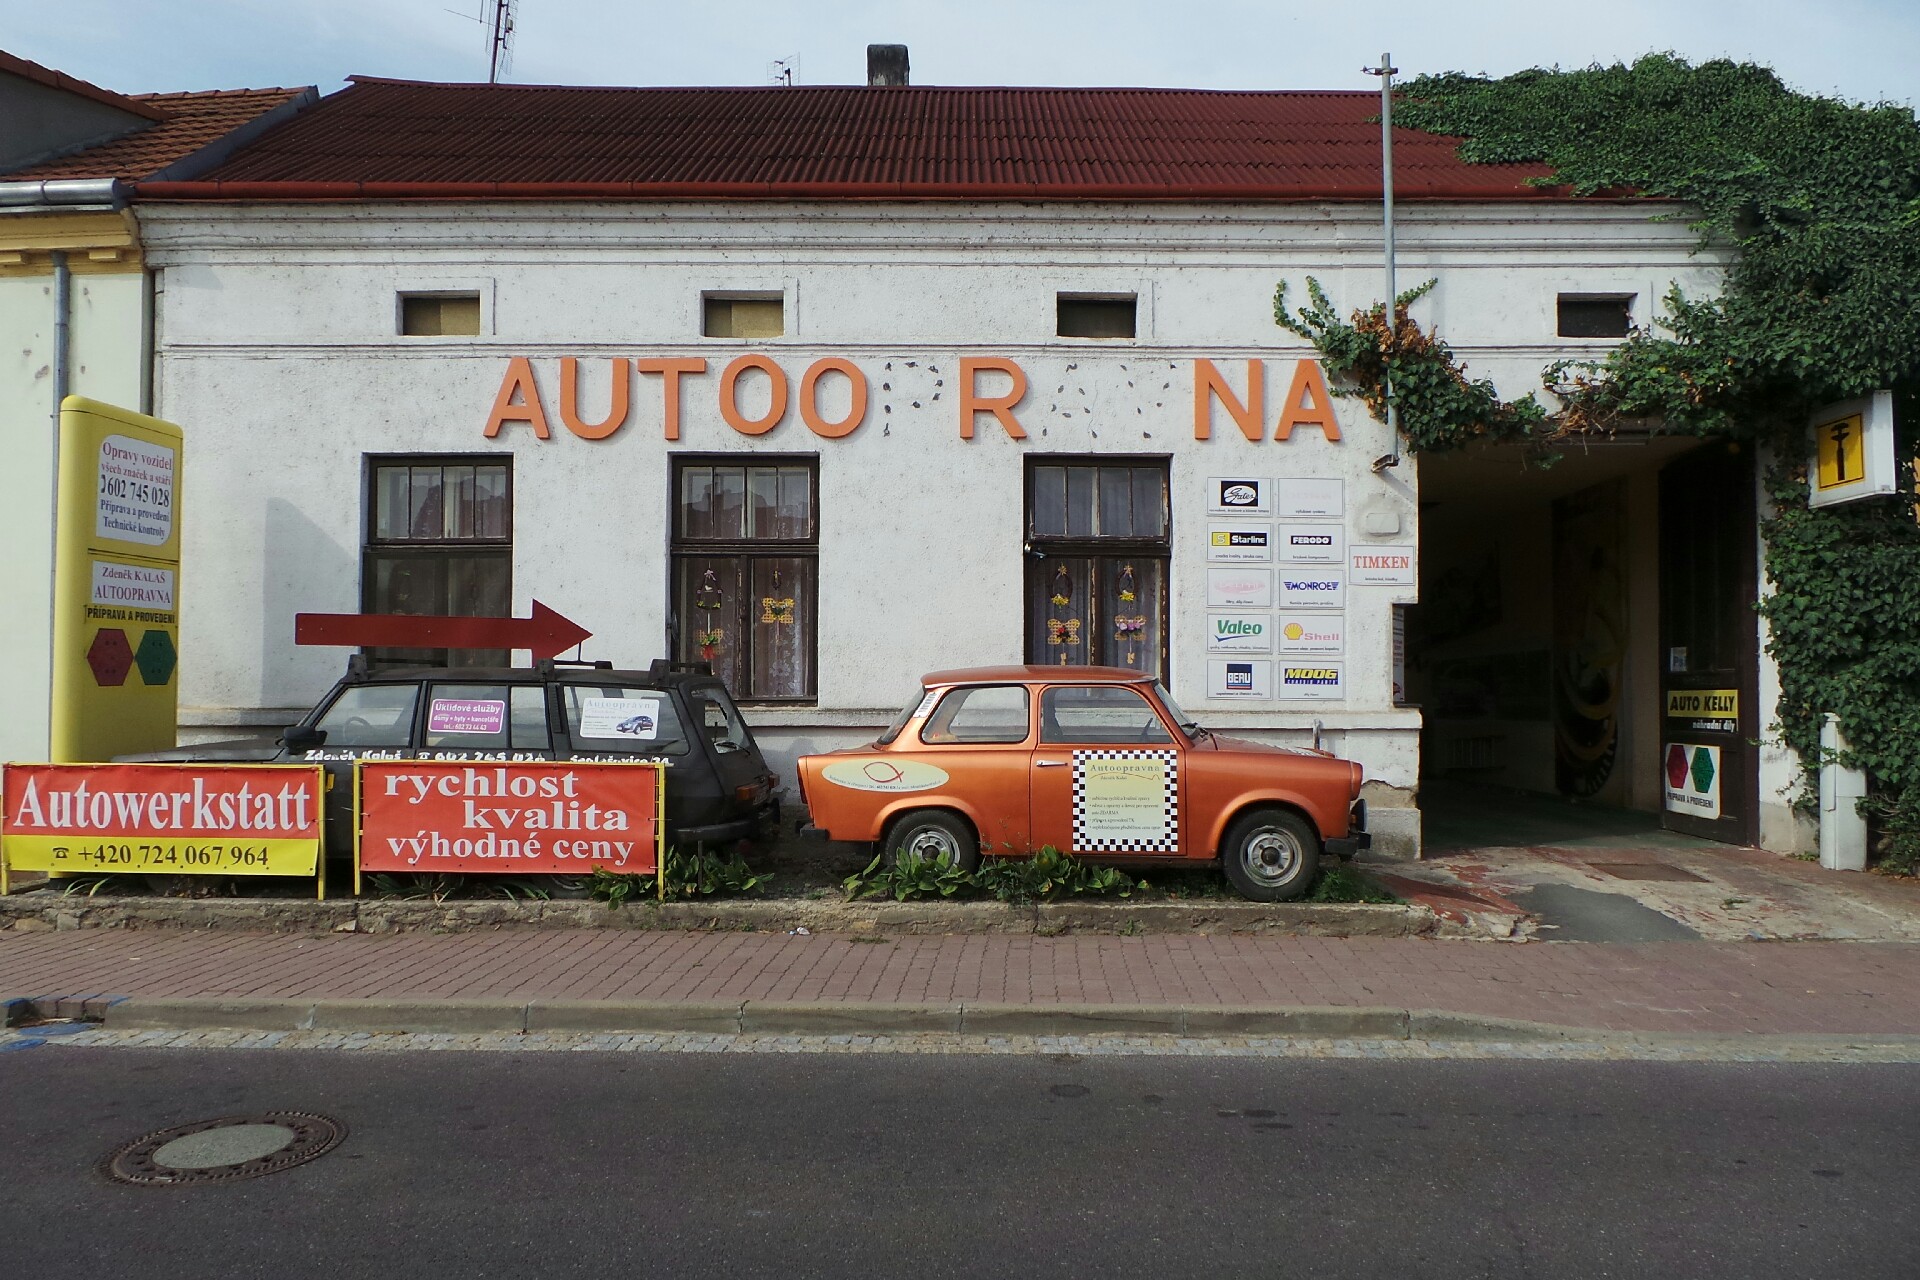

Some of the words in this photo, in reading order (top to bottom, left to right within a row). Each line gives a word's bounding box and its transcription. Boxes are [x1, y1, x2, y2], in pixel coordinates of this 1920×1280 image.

[103, 442, 138, 465] Opravy
[142, 455, 172, 470] vozidel
[102, 462, 122, 474] všech
[124, 468, 148, 480] značek
[108, 477, 126, 498] 602
[130, 482, 148, 502] 745
[152, 486, 170, 507] 028
[100, 499, 130, 514] Příprava
[103, 516, 136, 532] Technické
[138, 522, 165, 540] kontroly
[1231, 534, 1265, 544] Starline
[1353, 556, 1410, 568] TIMKEN
[102, 566, 132, 580] Zdeněk
[134, 571, 166, 584] KALAŠ
[94, 585, 170, 604] AUTOOPRAVNA
[1290, 582, 1332, 590] MONROE
[88, 606, 126, 620] PŘÍPRAVA
[128, 611, 134, 620] A
[1217, 620, 1262, 634] Valeo
[1286, 669, 1337, 679] MOOG
[436, 702, 471, 712] Úklidové
[473, 704, 500, 714] služby
[1670, 696, 1700, 711] AUTO
[1704, 696, 1735, 712] KELLY
[1090, 765, 1160, 774] Autoopravna
[384, 768, 579, 804] rychlost
[13, 774, 310, 830] Autowerkstatt
[462, 800, 629, 831] kvalita
[78, 845, 131, 864] +420
[139, 846, 177, 864] 724
[185, 846, 223, 865] 067
[230, 846, 268, 866] 964
[386, 830, 541, 864] výhodné
[552, 840, 635, 866] ceny
